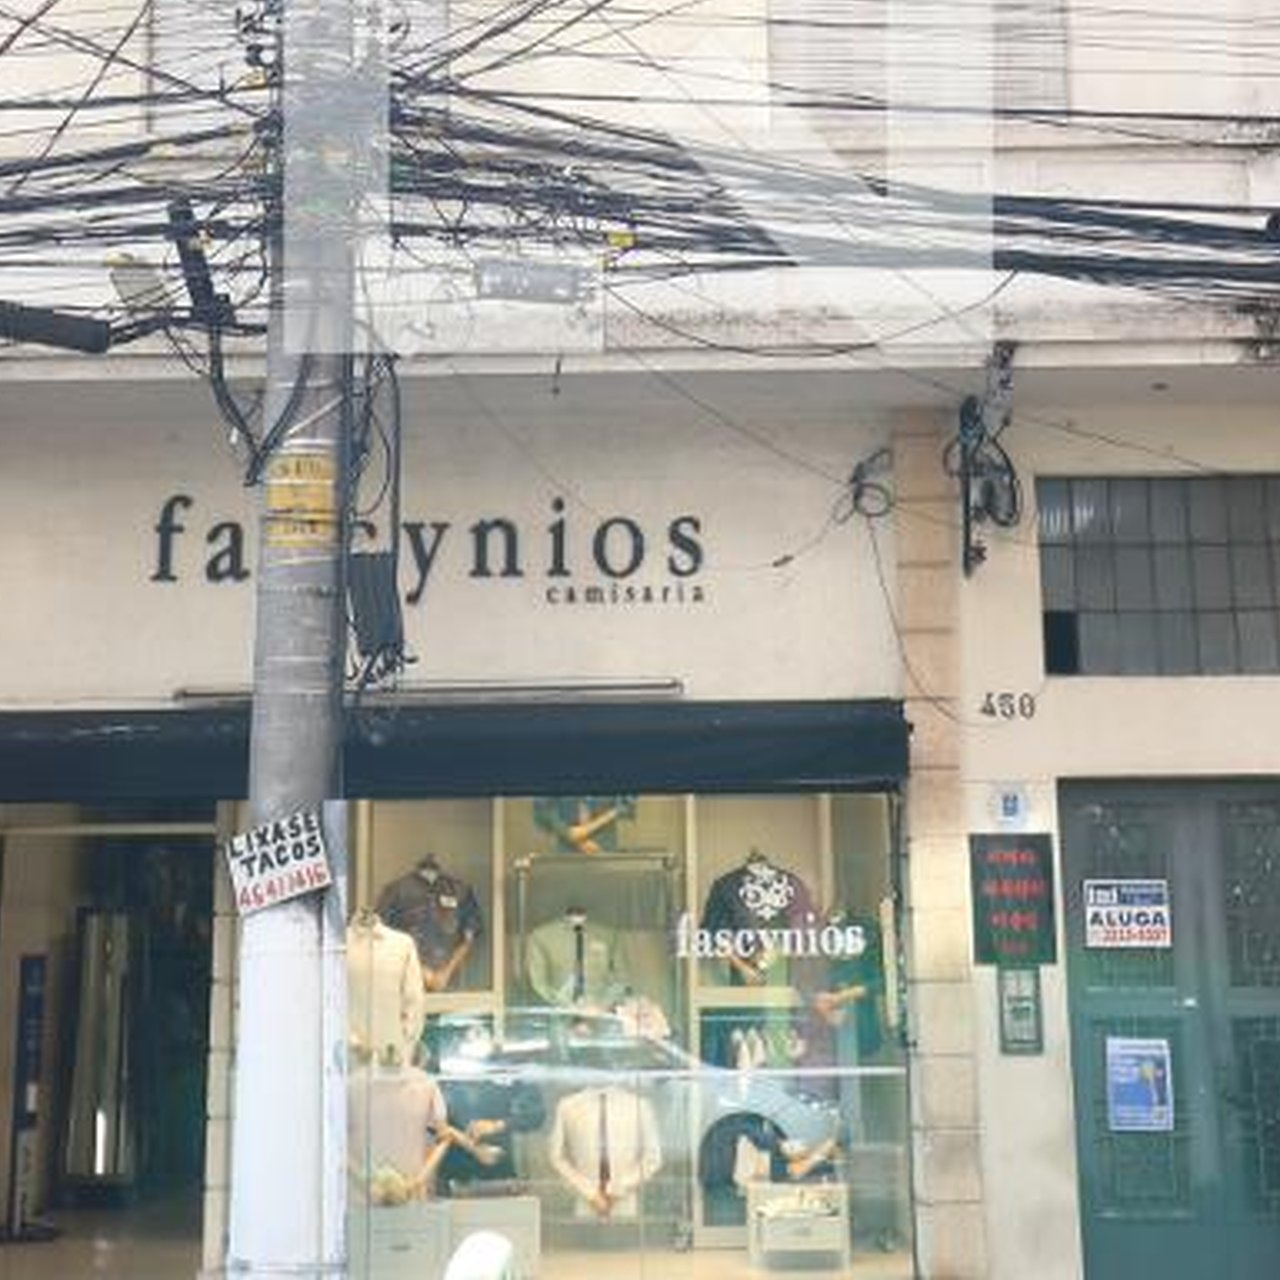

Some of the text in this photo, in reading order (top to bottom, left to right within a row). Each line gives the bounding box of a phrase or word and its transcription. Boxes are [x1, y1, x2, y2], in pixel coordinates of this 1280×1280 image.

[150, 496, 705, 604] faynios
[546, 584, 706, 605] camisaria
[980, 692, 1035, 720] 450
[240, 835, 321, 878] TACOS
[1089, 910, 1167, 928] ALUGA
[675, 911, 867, 969] fascynios
